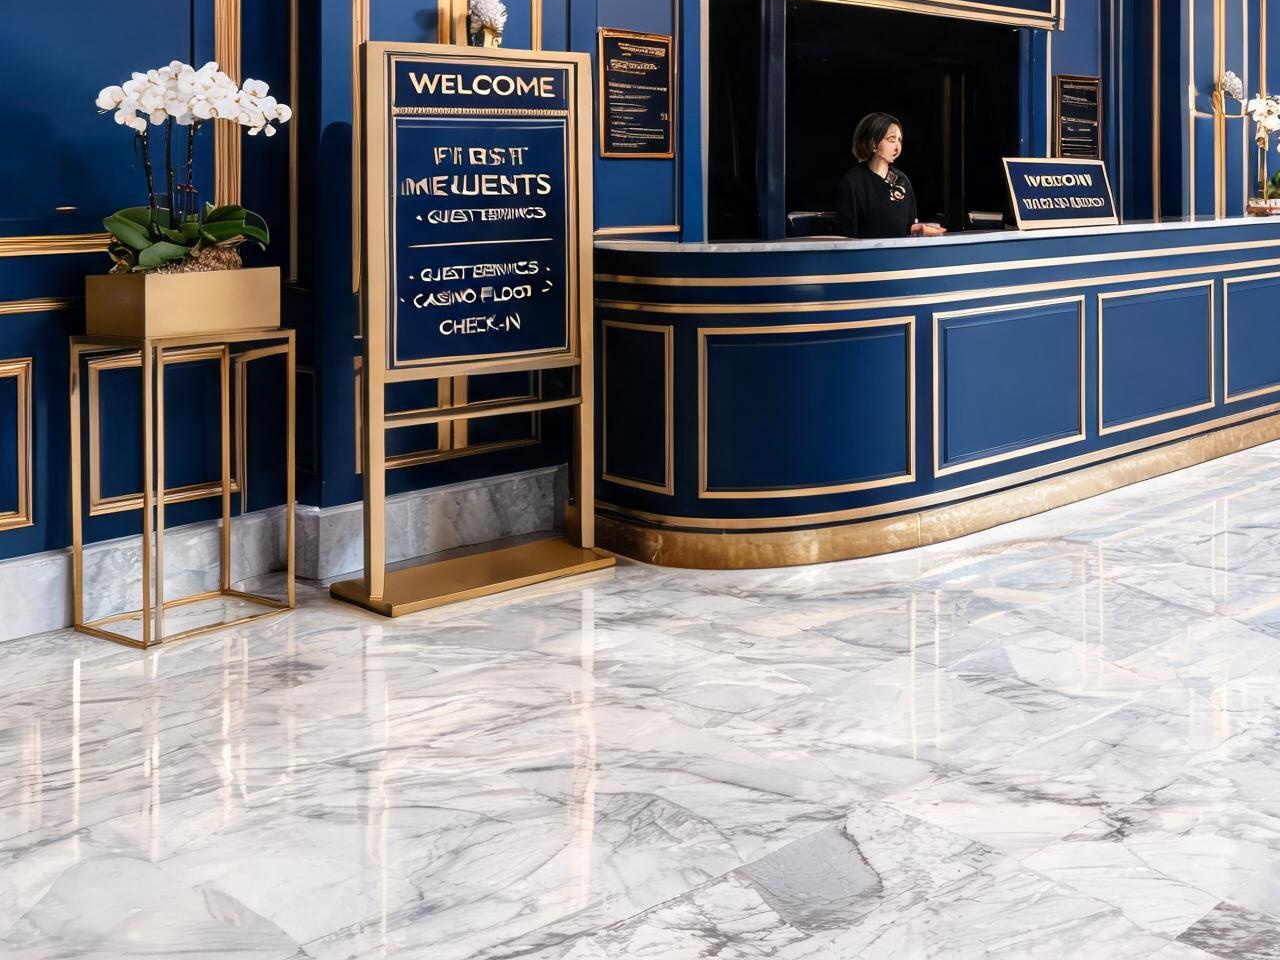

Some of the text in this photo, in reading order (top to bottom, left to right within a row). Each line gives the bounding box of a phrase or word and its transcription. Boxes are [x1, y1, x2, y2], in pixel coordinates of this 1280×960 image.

[408, 71, 556, 98] WELCOME
[413, 288, 477, 309] CASINO
[439, 312, 521, 335] CHECK-IN
